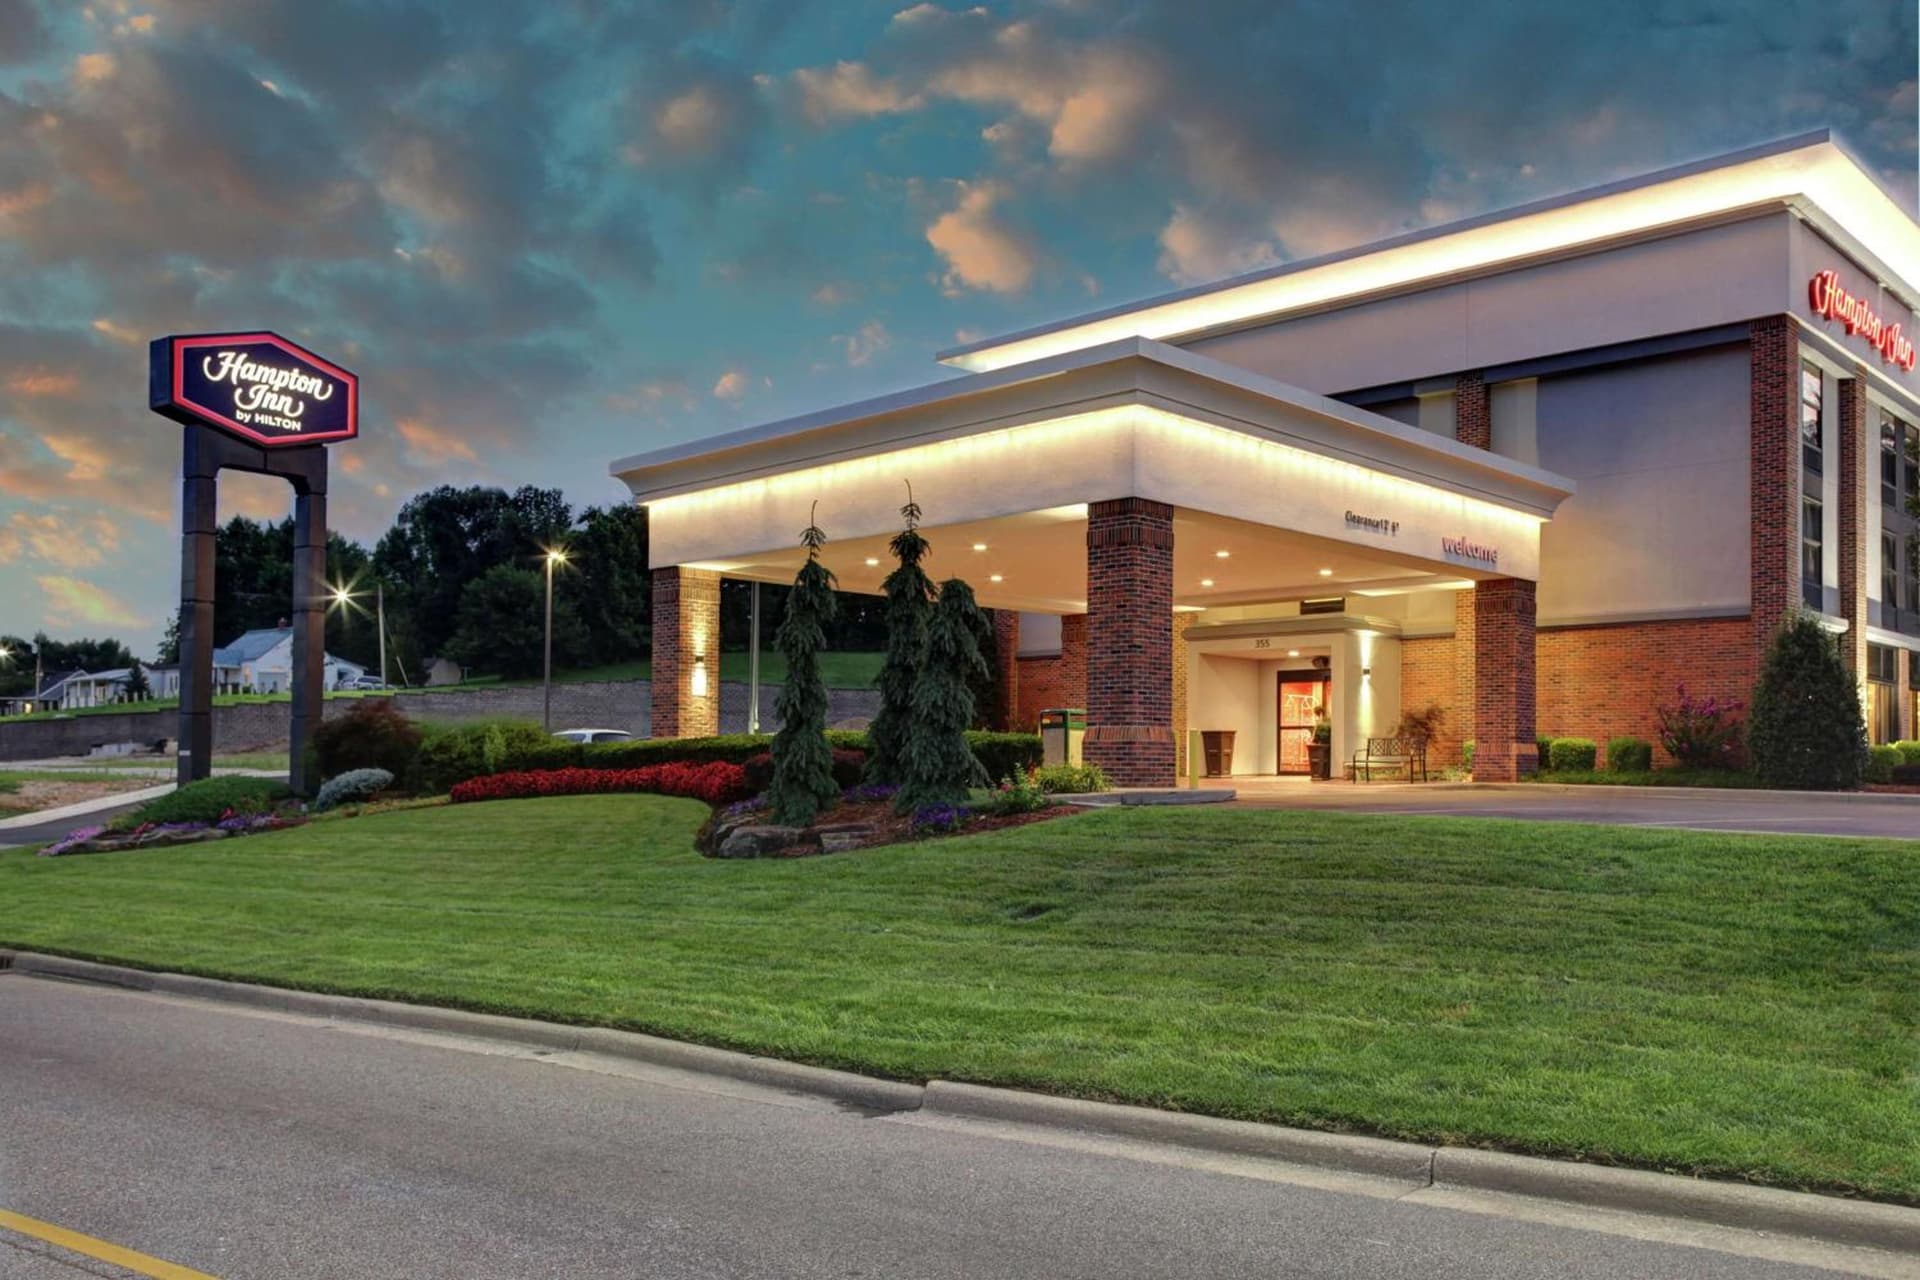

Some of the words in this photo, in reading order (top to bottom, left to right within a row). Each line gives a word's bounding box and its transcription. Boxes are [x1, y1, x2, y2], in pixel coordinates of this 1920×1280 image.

[1809, 270, 1885, 349] Hampton
[1884, 323, 1916, 371] Inn
[204, 352, 332, 400] Hampton
[235, 385, 304, 417] Inn
[236, 409, 251, 423] by
[254, 413, 302, 431] HILTON
[1442, 537, 1498, 563] welcome
[1255, 639, 1270, 648] 355
